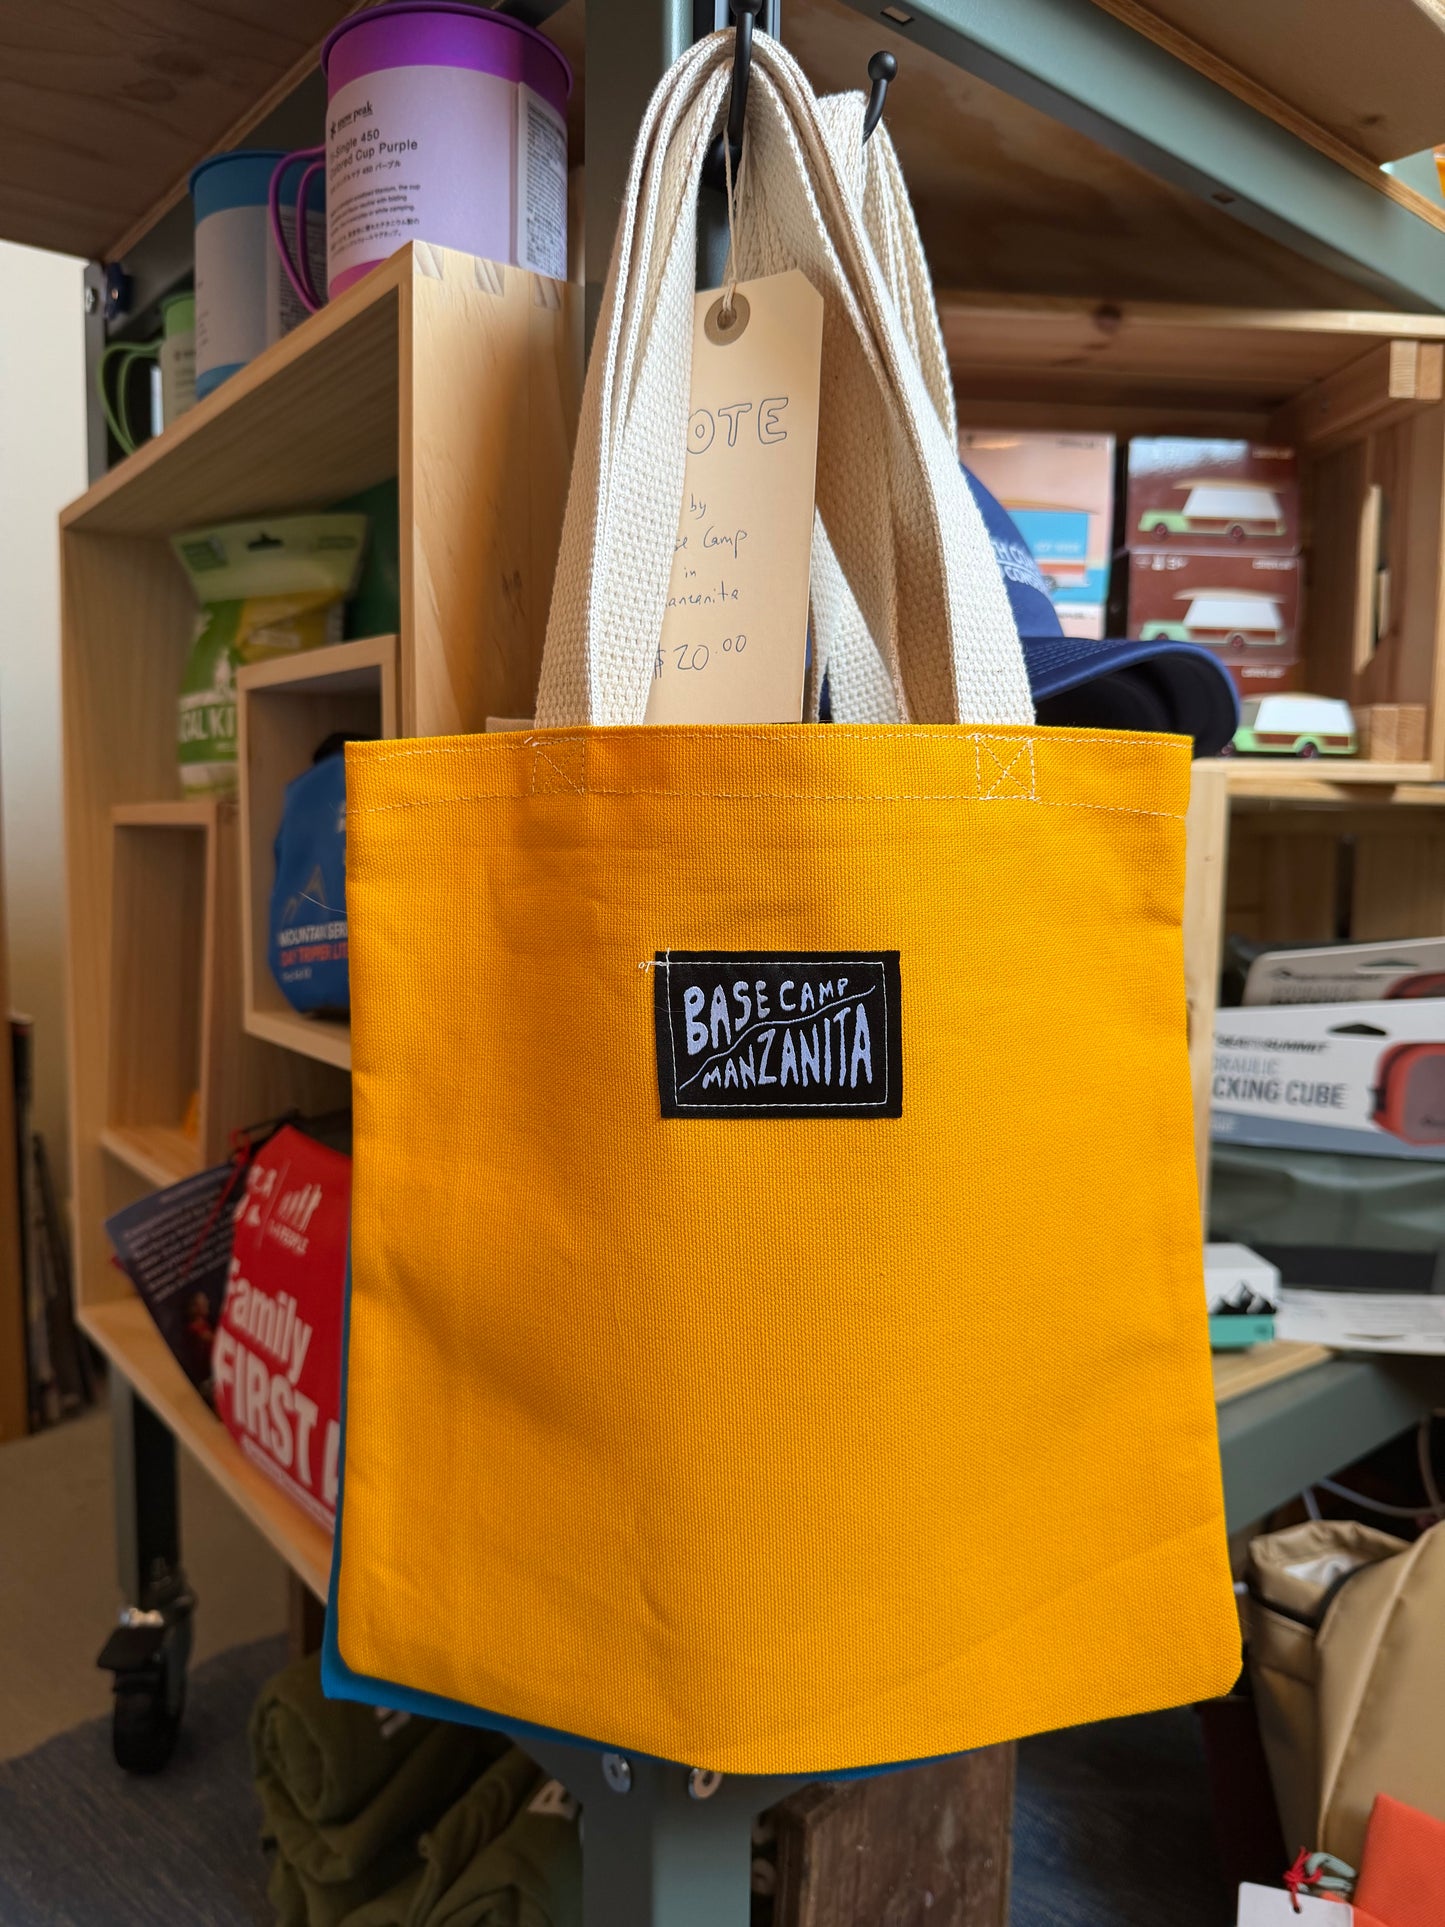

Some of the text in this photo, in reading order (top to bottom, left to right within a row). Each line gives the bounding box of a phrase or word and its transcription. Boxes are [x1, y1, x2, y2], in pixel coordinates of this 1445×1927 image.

[355, 147, 375, 161] Cup
[379, 138, 418, 154] Purple
[361, 128, 380, 143] 450
[690, 493, 706, 520] by
[703, 526, 748, 559] Camp
[684, 567, 696, 578] in
[683, 978, 849, 1056] BASE CAMP
[702, 1003, 873, 1089] MANZANITA
[1286, 1080, 1347, 1109] CUBE
[213, 1325, 319, 1488] FIRST
